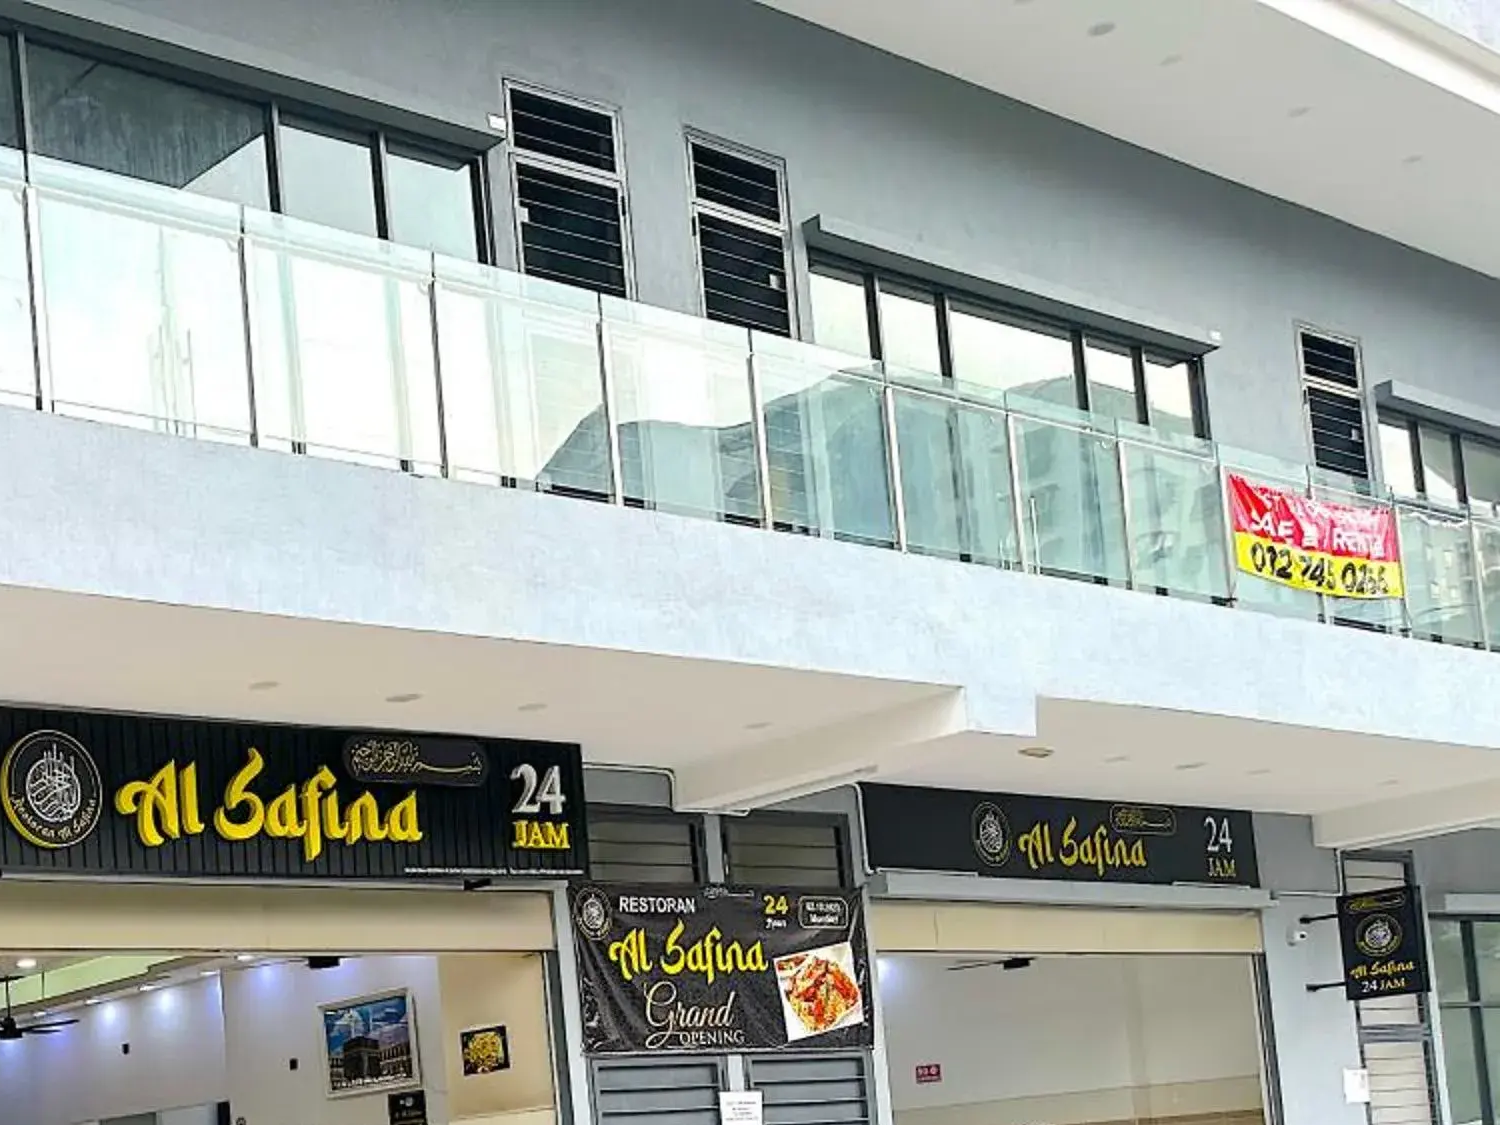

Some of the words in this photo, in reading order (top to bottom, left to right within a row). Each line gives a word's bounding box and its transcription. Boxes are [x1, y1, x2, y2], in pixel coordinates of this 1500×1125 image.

[510, 763, 566, 815] 24
[115, 759, 205, 847] Al
[214, 747, 423, 862] Safina
[511, 820, 571, 850] JAM
[1017, 821, 1054, 870] Al
[1059, 815, 1147, 877] Safina
[1203, 816, 1232, 852] 24
[1207, 857, 1237, 877] JAM
[619, 896, 695, 913] RESTORAN
[764, 895, 788, 914] 24
[609, 928, 652, 981] Al
[660, 918, 769, 986] Safina
[1361, 980, 1378, 993] 24
[644, 980, 736, 1049] Grand
[679, 1028, 746, 1046] OPENING
